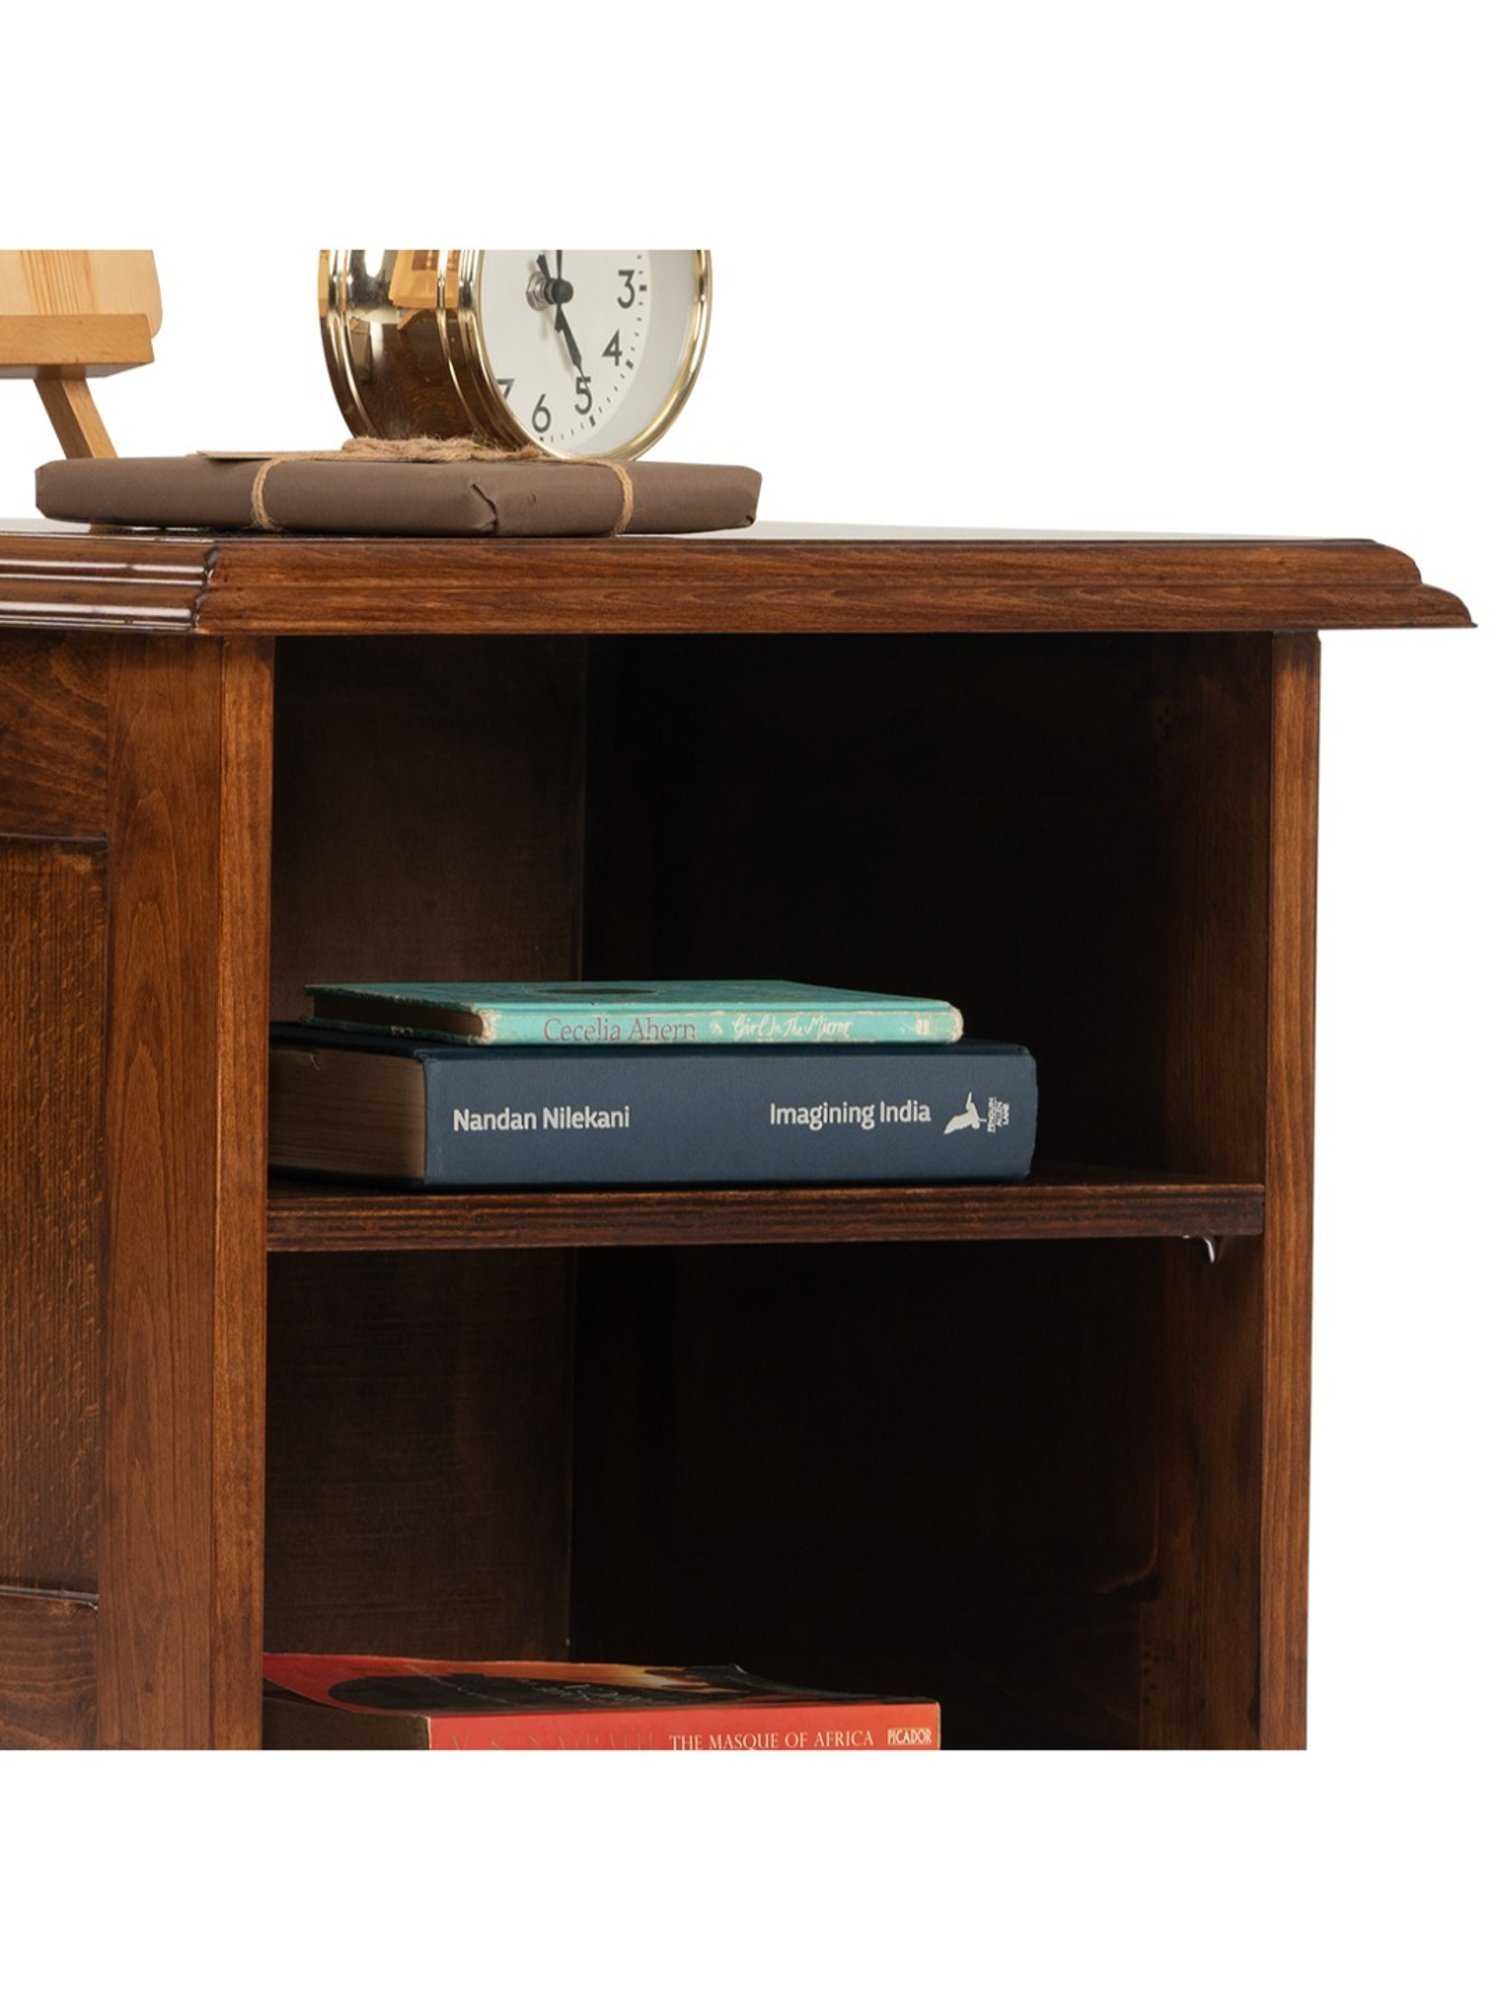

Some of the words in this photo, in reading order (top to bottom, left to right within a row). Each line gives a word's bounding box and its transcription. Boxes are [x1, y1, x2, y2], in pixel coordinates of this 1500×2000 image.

[617, 269, 635, 309] 3
[602, 328, 622, 367] 4
[575, 376, 592, 415] 5
[532, 393, 551, 434] 6
[544, 1016, 621, 1041] Cecelia
[628, 1016, 696, 1041] Ahern
[732, 1014, 769, 1041] Girl
[453, 1107, 537, 1131] Nandan
[542, 1106, 630, 1129] Nilekani
[770, 1101, 875, 1131] Imagining
[880, 1100, 931, 1123] India
[669, 1734, 703, 1750] THE
[709, 1733, 779, 1750] MASQUE
[784, 1731, 808, 1748] OF
[814, 1729, 875, 1748] AFRICA
[887, 1727, 932, 1746] PICADOR
